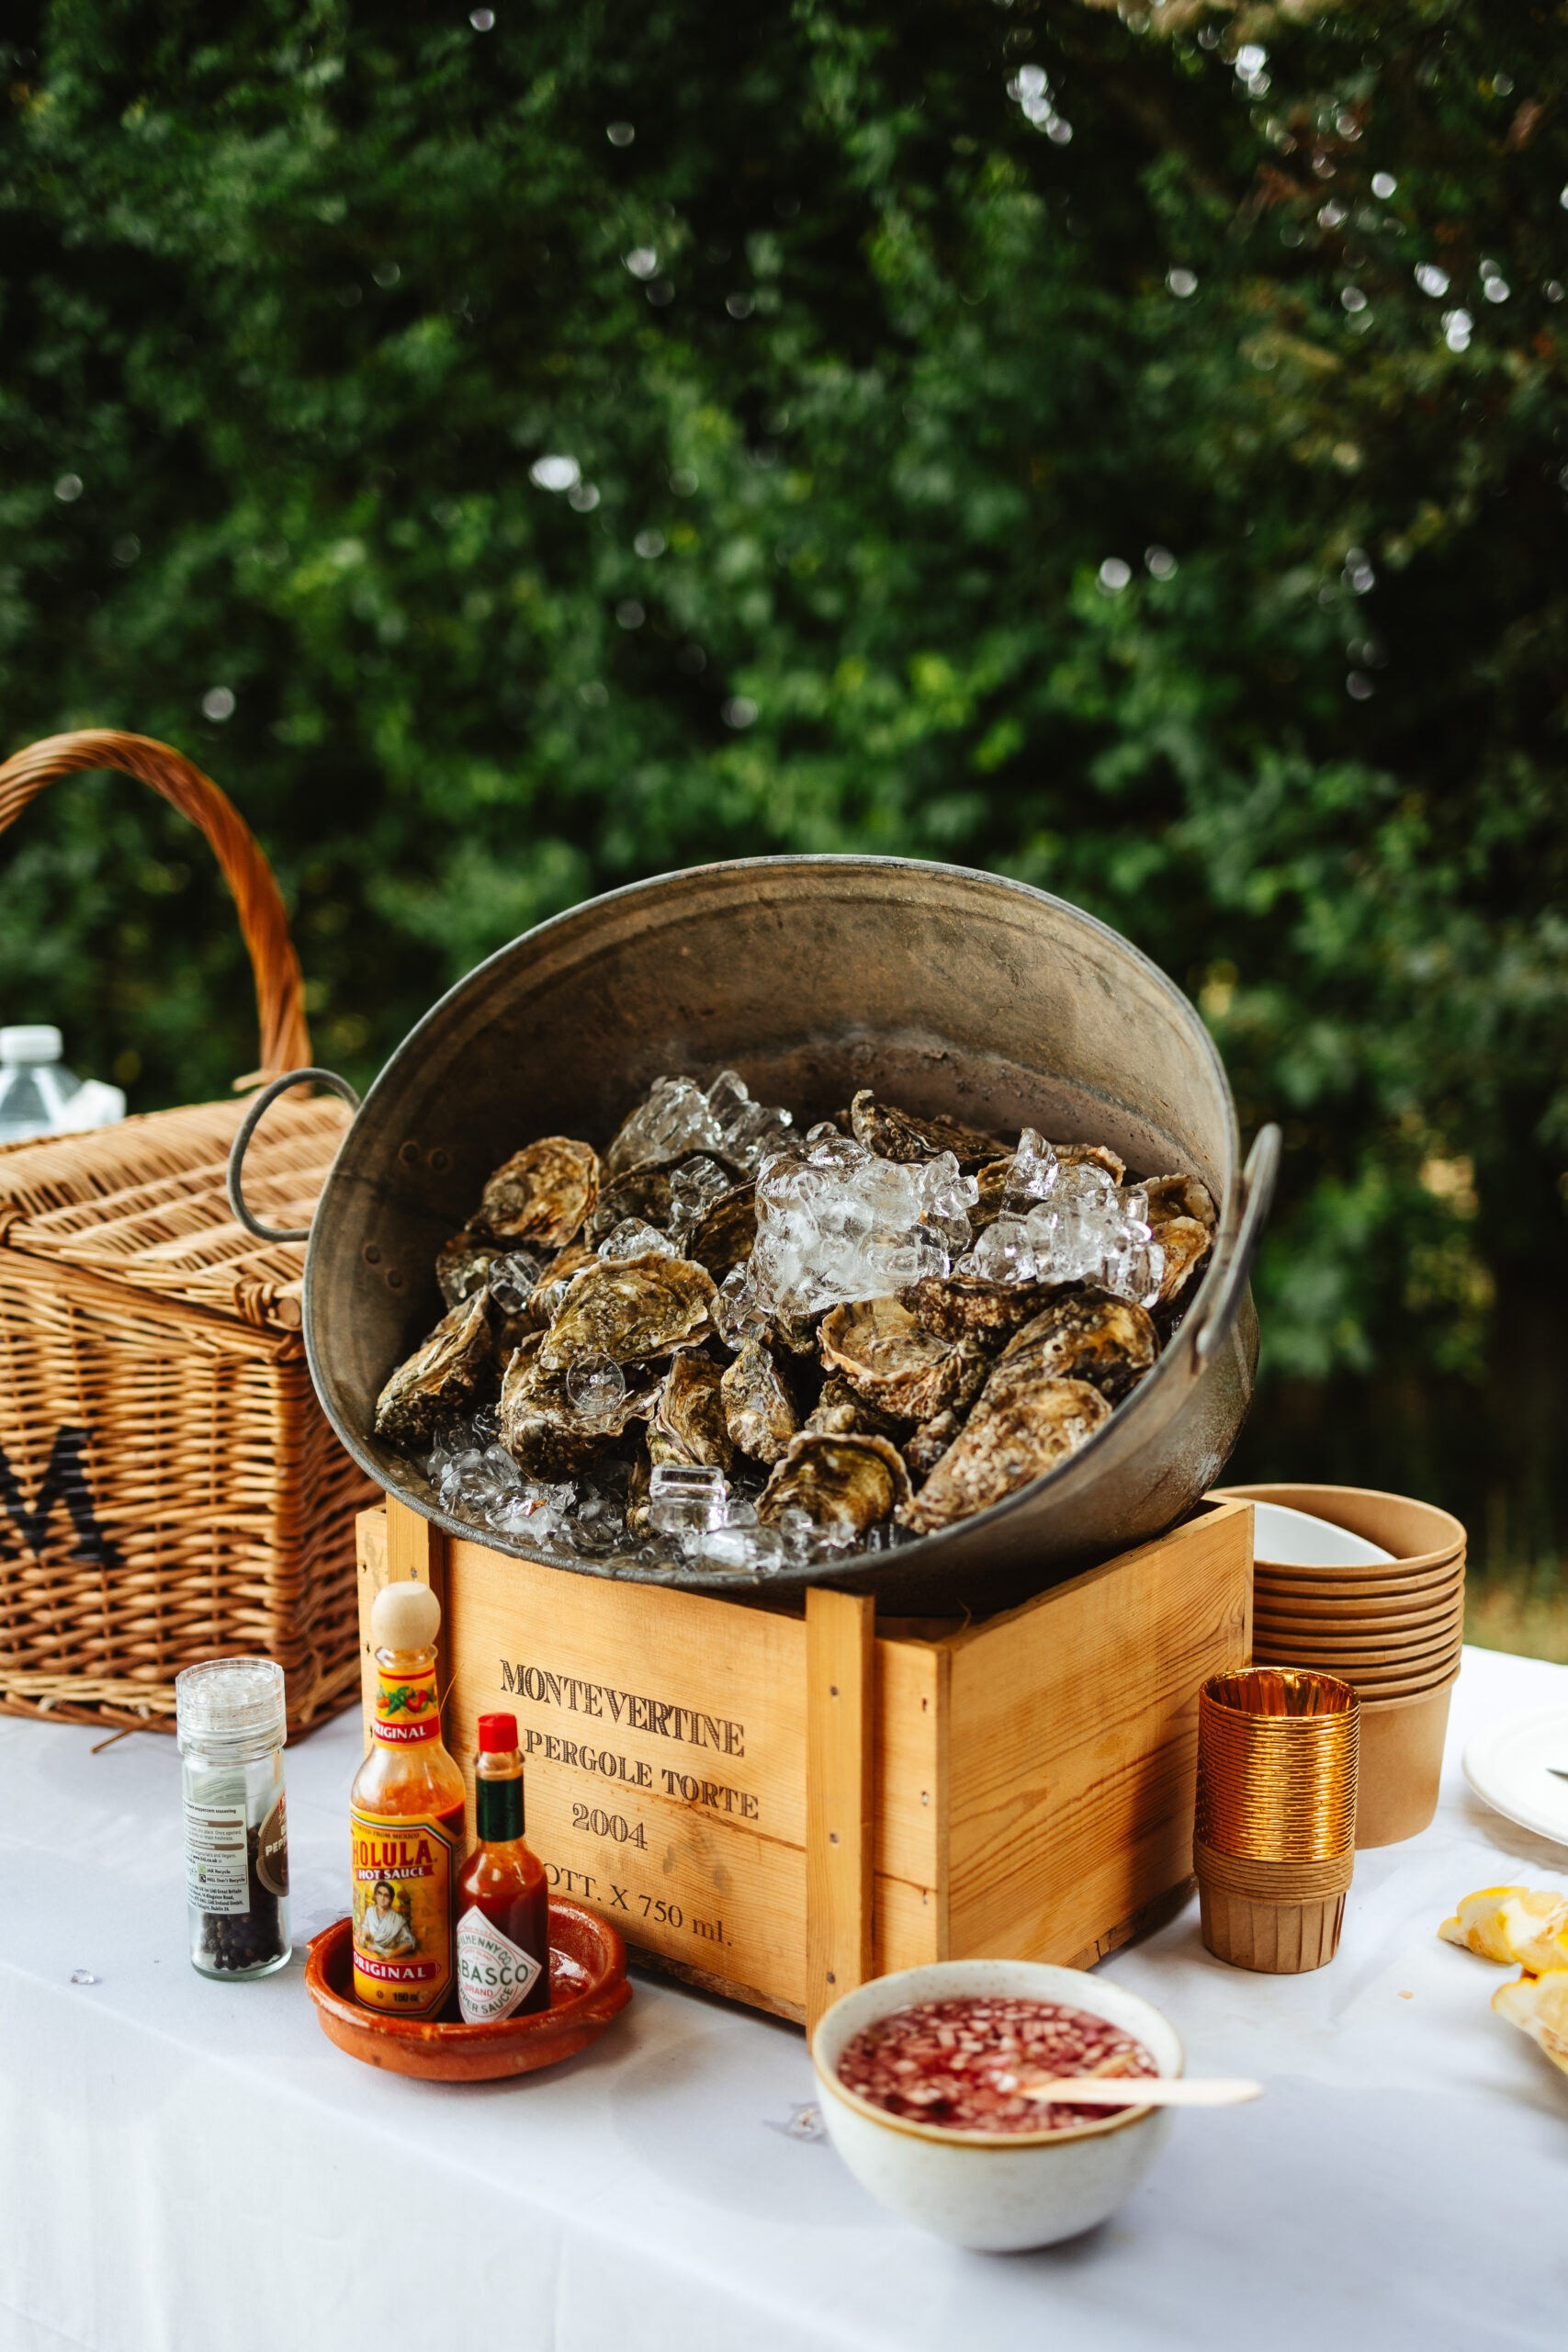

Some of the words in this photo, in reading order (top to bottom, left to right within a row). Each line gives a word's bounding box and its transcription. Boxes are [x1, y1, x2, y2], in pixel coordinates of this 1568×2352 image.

[500, 1659, 745, 1758] MONTEVERTINE
[374, 1721, 426, 1739] RIGINAL
[525, 1728, 652, 1789] PERGOLE
[661, 1768, 759, 1820] TORTE
[572, 1803, 649, 1851] 2004
[353, 1839, 433, 1867] HOLULA
[358, 1869, 380, 1880] HOT
[384, 1867, 424, 1879] SAUCE
[543, 1862, 602, 1902] OTT.
[610, 1883, 631, 1911] X
[638, 1895, 683, 1928] 750
[693, 1918, 733, 1947] ml.
[459, 1932, 502, 1954] ILHENNY
[354, 1951, 426, 1979] ORIGINAL
[459, 1959, 528, 1986] BASCO
[393, 1992, 409, 2002] 150
[460, 1988, 479, 2013] PPER
[481, 1986, 513, 2015] SAUCE
[464, 1982, 493, 1997] BRAND
